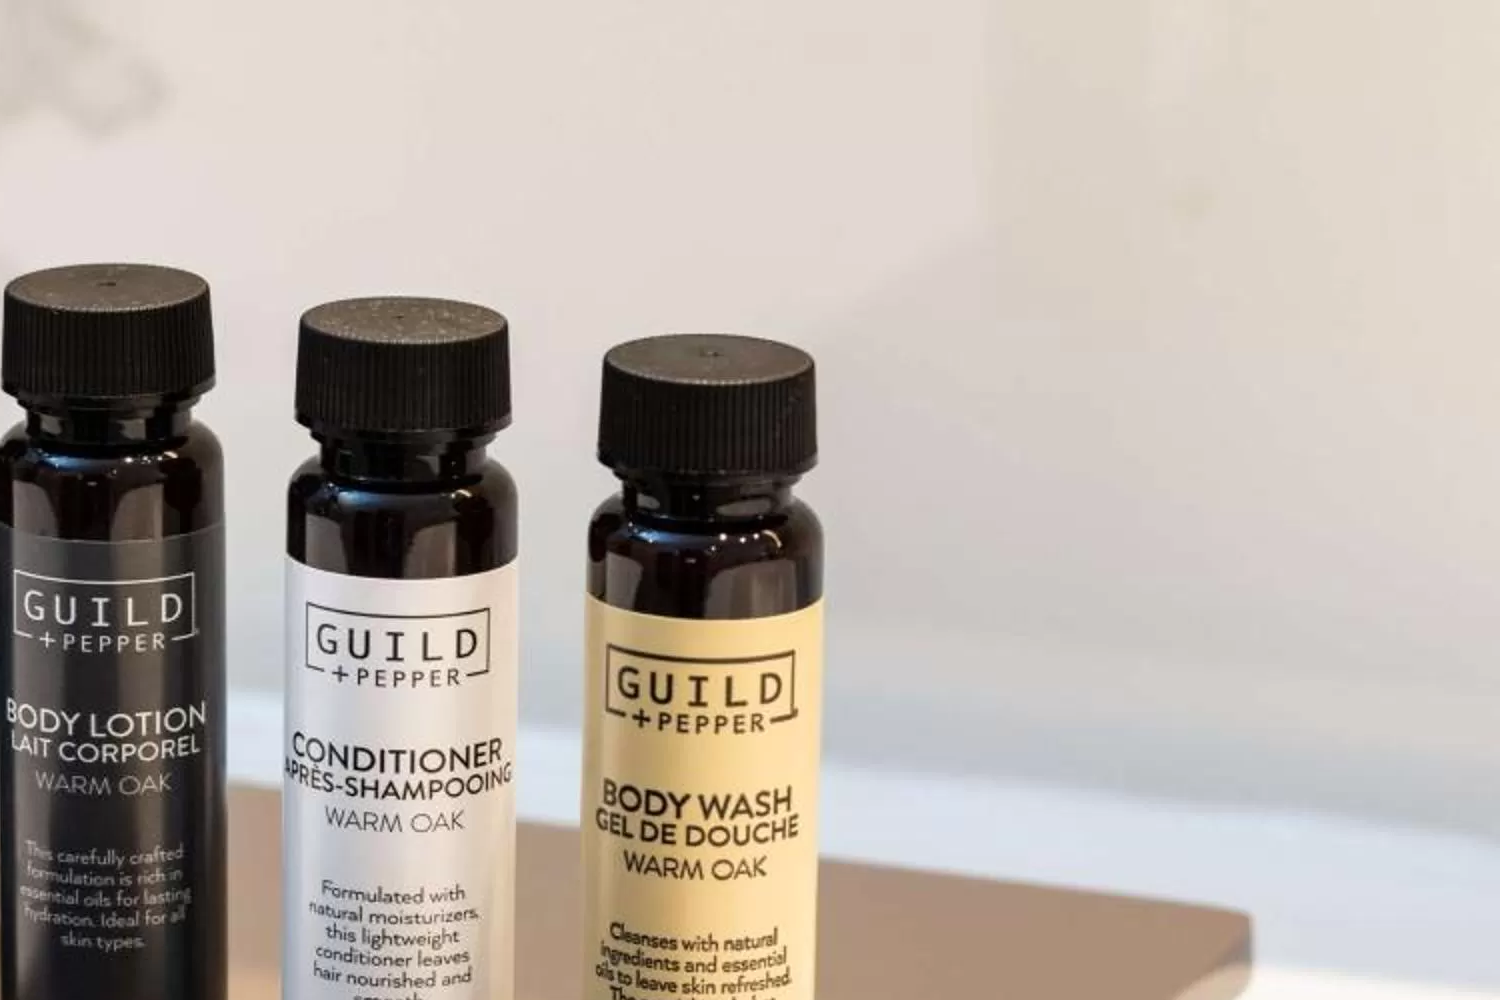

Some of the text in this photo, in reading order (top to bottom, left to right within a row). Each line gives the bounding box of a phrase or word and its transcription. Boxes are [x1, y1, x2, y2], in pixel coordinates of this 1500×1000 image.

[23, 589, 183, 627] GUILD
[317, 623, 477, 662] GUILD
[617, 665, 782, 708] GUILD
[7, 697, 206, 738] BODY LOTION
[11, 730, 200, 763] LAIT CORPOREL
[293, 731, 503, 774] CONDITIONER
[36, 771, 173, 795] WARM OAK
[603, 778, 792, 821] BODY WASH
[325, 805, 465, 833] WARM OAK
[596, 808, 799, 848] GEL DE DOUCHE
[57, 849, 125, 869] carefully
[130, 843, 184, 865] crafted
[624, 849, 768, 881] WARM OAK
[27, 863, 115, 886] formulation
[120, 873, 132, 887] is
[138, 868, 165, 885] rich
[84, 891, 111, 908] oils
[117, 891, 139, 907] for
[321, 879, 466, 904] Formulated with
[101, 911, 139, 928] Ideal
[145, 911, 166, 927] for
[309, 902, 363, 922] natural
[61, 931, 92, 948] skin
[325, 923, 460, 951] this lightweight
[610, 921, 779, 952] Cleanses with natural
[316, 945, 470, 967] conditioner leaves
[601, 940, 787, 973] ingredients and essential
[313, 961, 473, 988] hair nourished and
[617, 971, 633, 986] to
[636, 971, 677, 993] leave
[682, 975, 716, 995] skin
